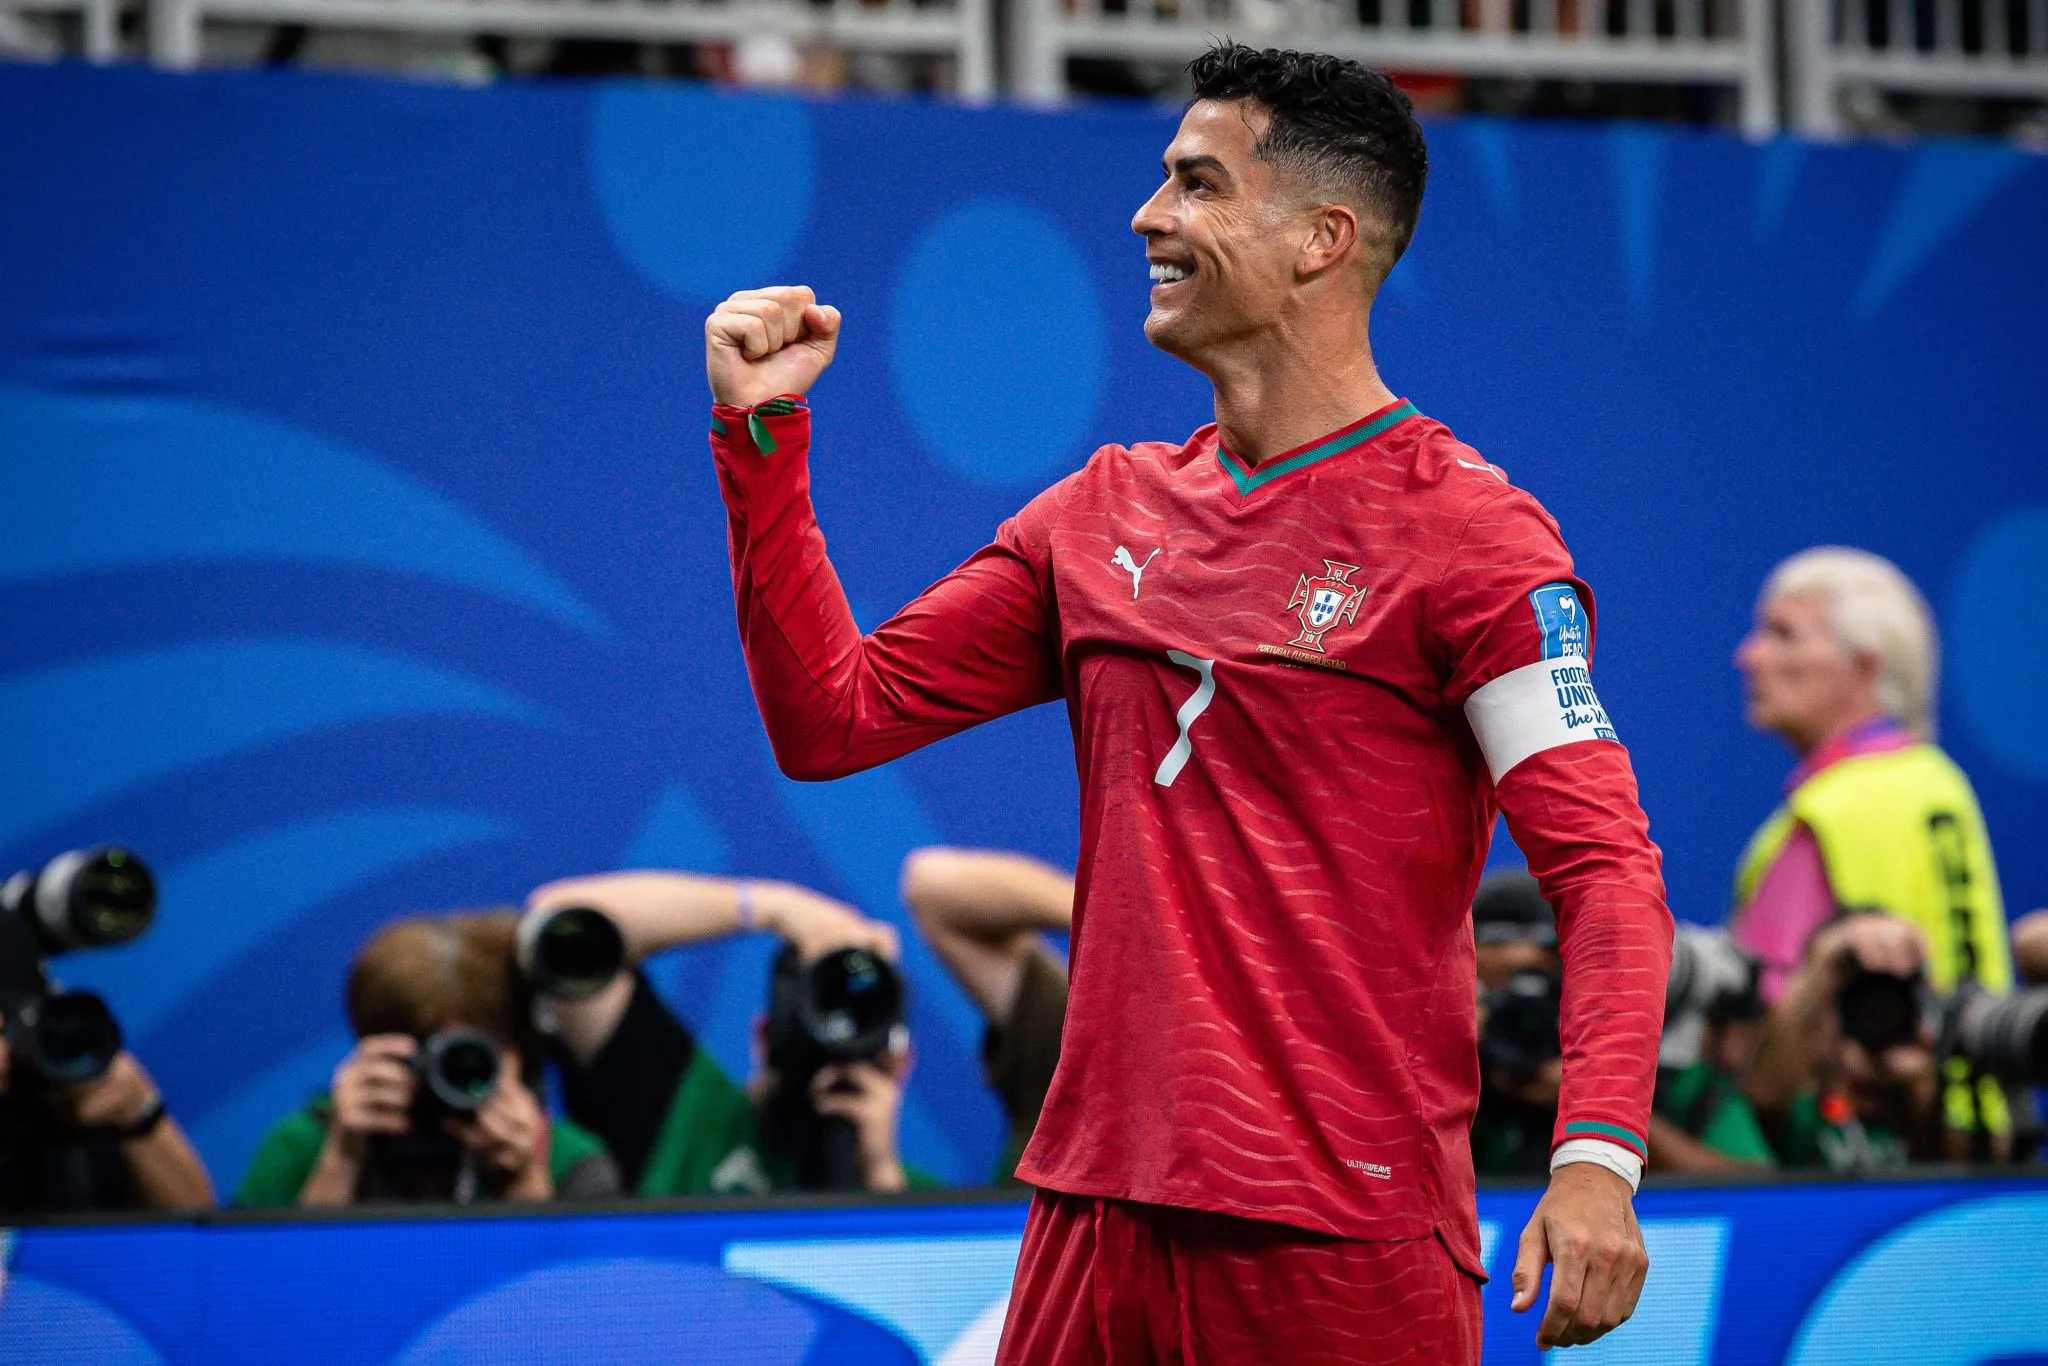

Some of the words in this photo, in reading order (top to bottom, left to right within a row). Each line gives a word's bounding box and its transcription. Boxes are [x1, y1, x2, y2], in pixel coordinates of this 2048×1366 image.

[1256, 644, 1290, 658] PORTUGAL
[1556, 685, 1600, 708] UNIT
[1154, 650, 1216, 787] 7
[1560, 709, 1593, 729] the
